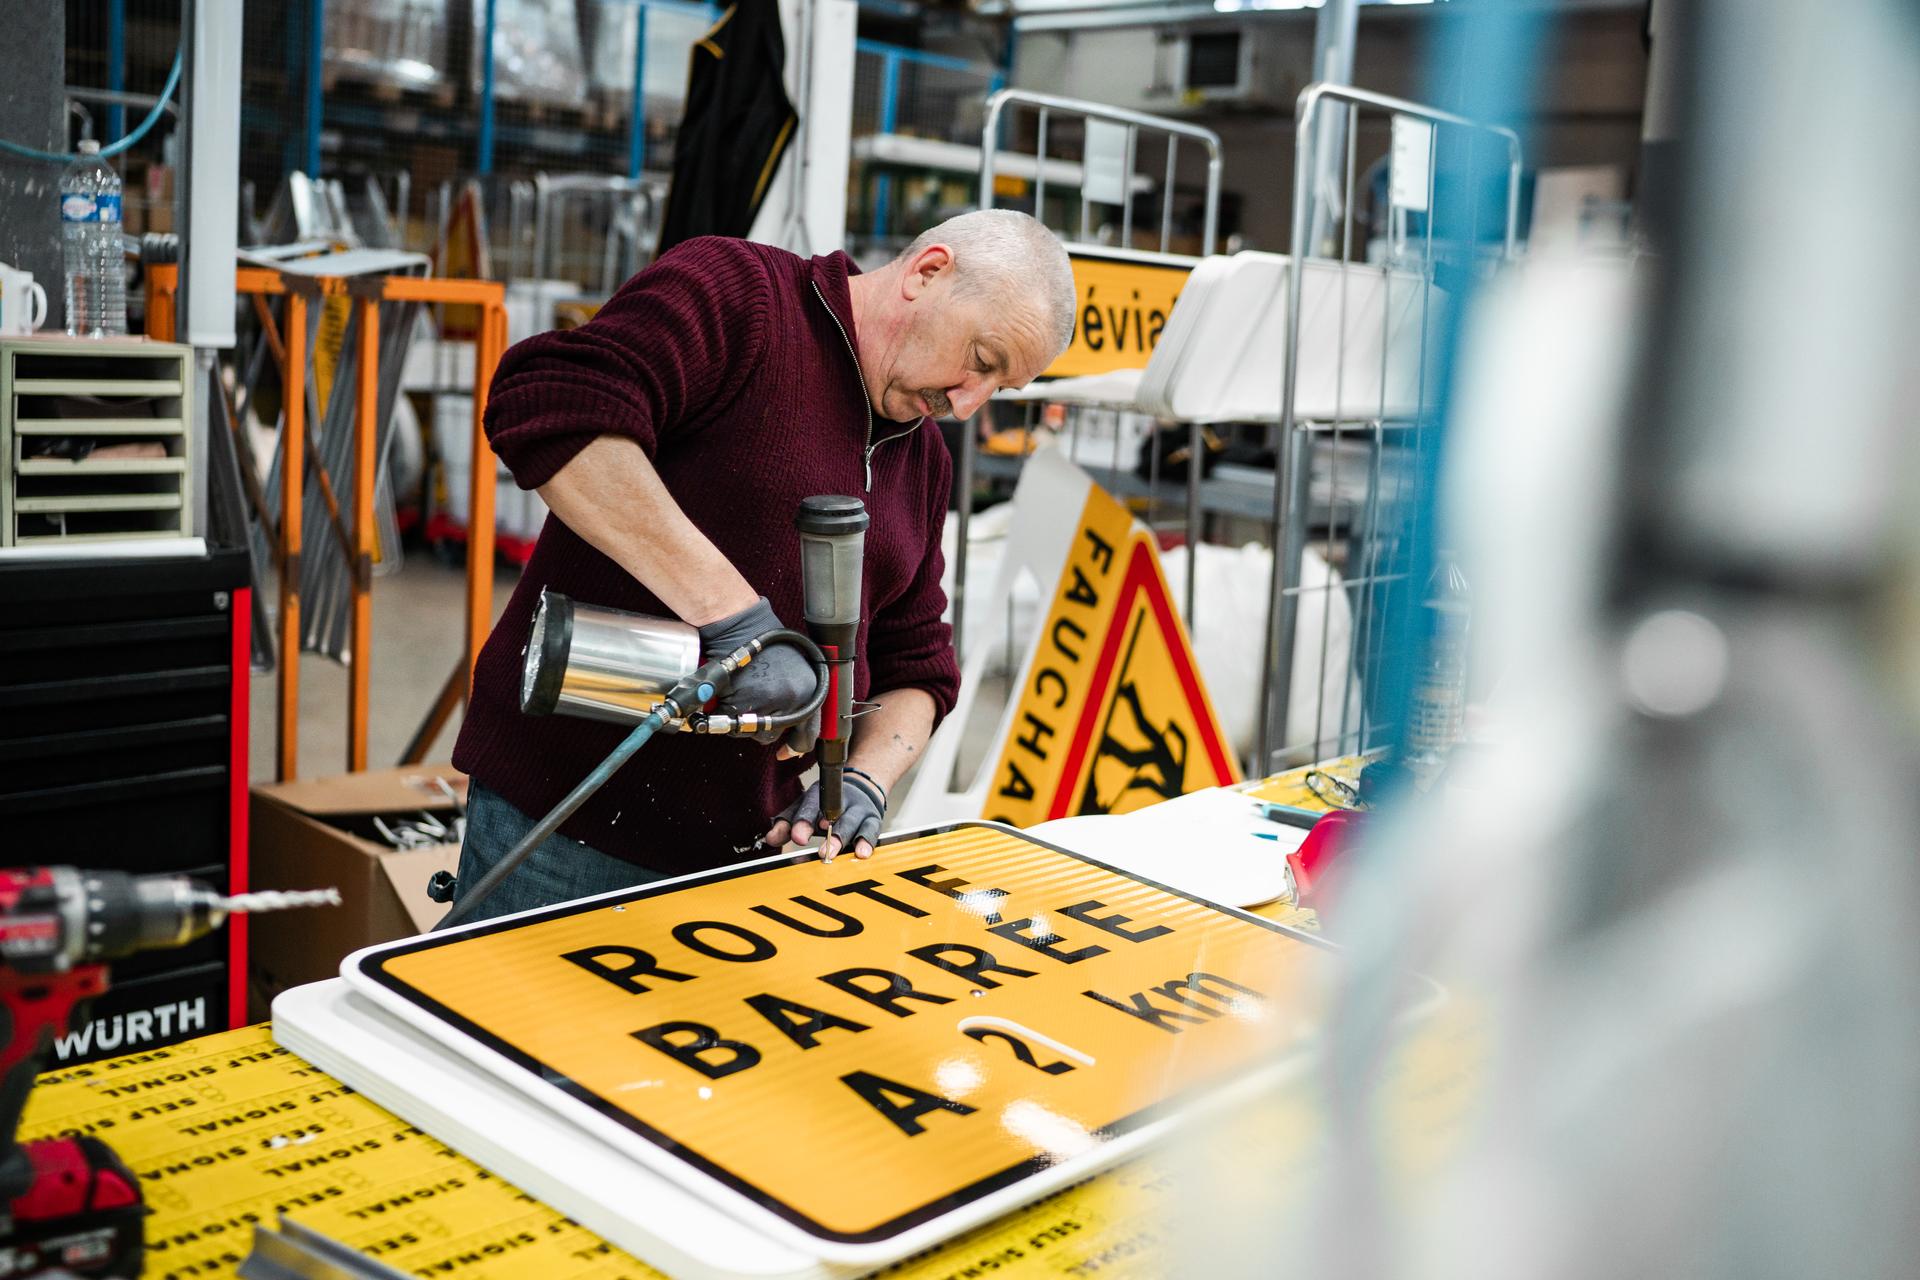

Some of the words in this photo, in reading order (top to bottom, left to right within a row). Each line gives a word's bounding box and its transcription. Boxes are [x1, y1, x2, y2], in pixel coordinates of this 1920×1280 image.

[1069, 285, 1178, 351] évia
[559, 864, 1011, 995] ROUTE
[628, 899, 1175, 1080] BARREE
[54, 997, 206, 1061] WÜRTH
[839, 1070, 980, 1137] A
[961, 1026, 1077, 1075] 2
[1081, 971, 1270, 1034] km
[100, 1065, 218, 1097] SIGNAL
[130, 1097, 197, 1120] SELF
[178, 1101, 298, 1136] SIGNAL
[138, 1146, 248, 1181] SIGNA
[262, 1139, 381, 1177] SIGNAL
[345, 1178, 466, 1219] SIGNAL
[144, 1212, 260, 1251] SIGNA
[361, 1232, 419, 1255] SEL
[413, 1232, 536, 1278] SIGNAL
